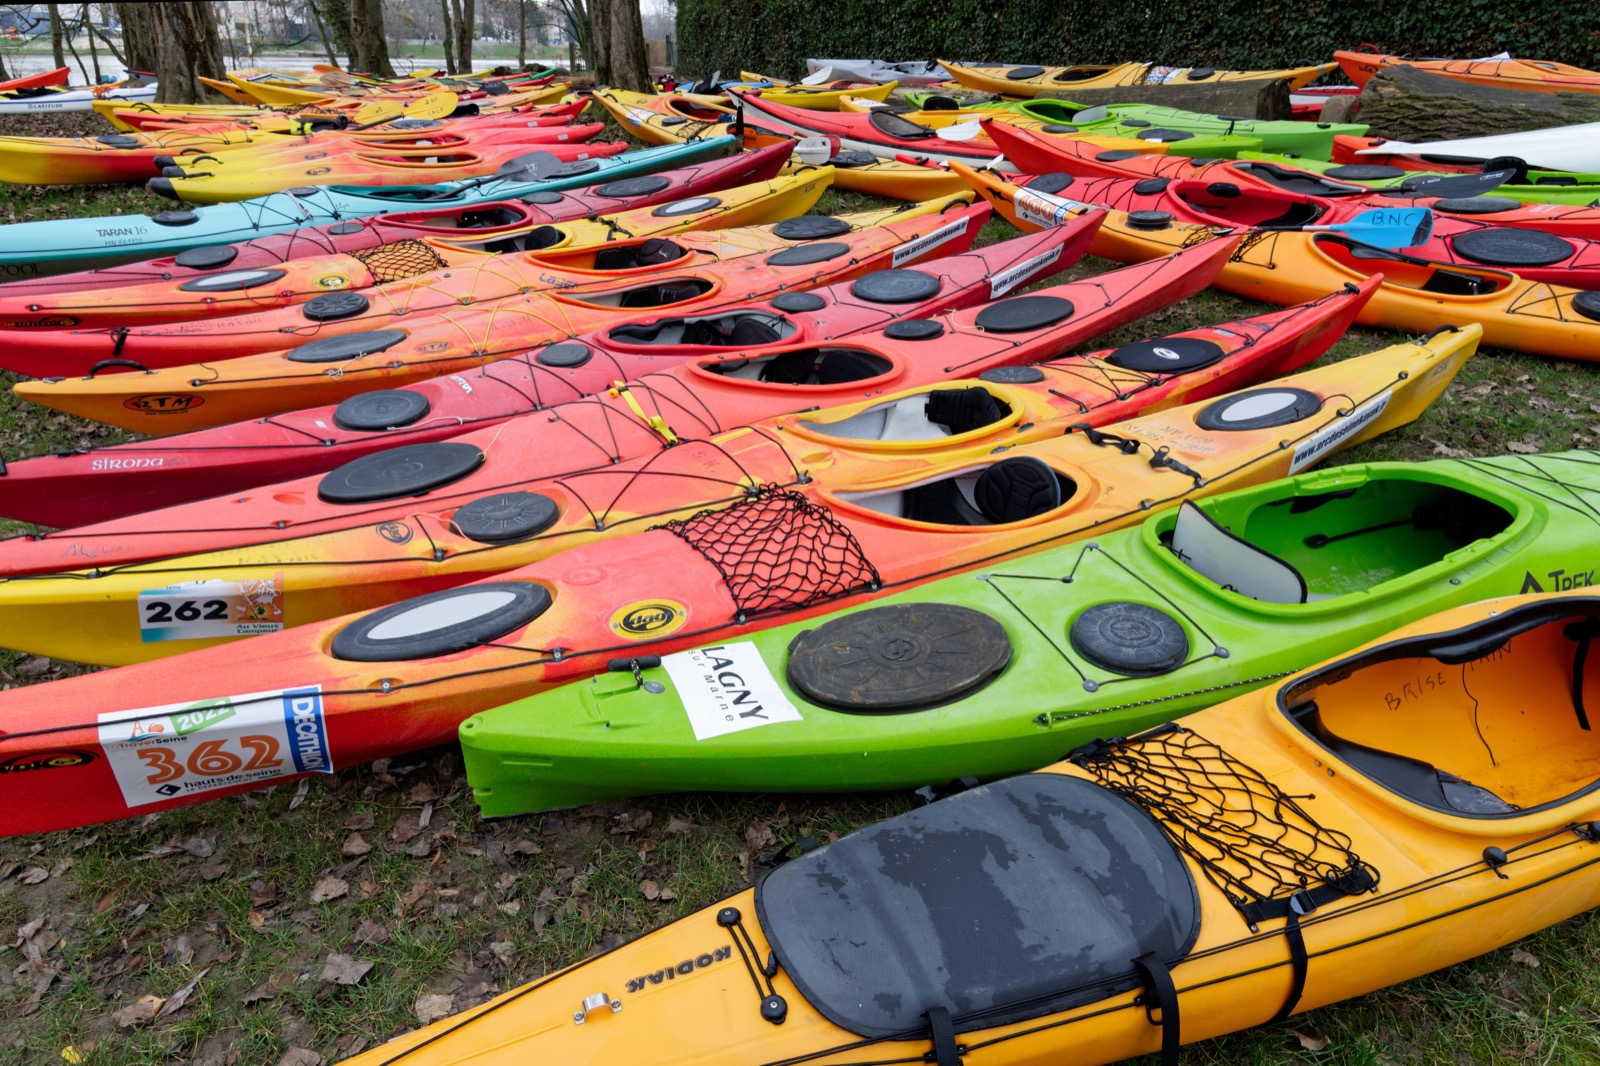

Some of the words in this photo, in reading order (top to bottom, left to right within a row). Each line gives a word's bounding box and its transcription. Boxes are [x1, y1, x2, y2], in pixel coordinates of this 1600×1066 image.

[1018, 193, 1057, 221] 400
[1371, 211, 1416, 227] BNC
[96, 228, 133, 238] TARAN
[133, 226, 148, 235] 16
[893, 222, 967, 262] www.arcdeseinekayak.fr
[992, 249, 1061, 293] www.arcdeseinekayak.fr
[131, 396, 194, 409] RTM
[1293, 400, 1388, 466] www.arcdeseinekayak.fr
[145, 599, 229, 623] 262
[688, 651, 705, 668] sur
[704, 674, 734, 723] Marne
[701, 646, 769, 720] LAGNY
[1384, 671, 1447, 712] BRISE
[176, 700, 231, 732] 2022
[291, 696, 321, 771] DECATHLON
[136, 734, 285, 785] 362
[625, 945, 732, 993] KODIAK
